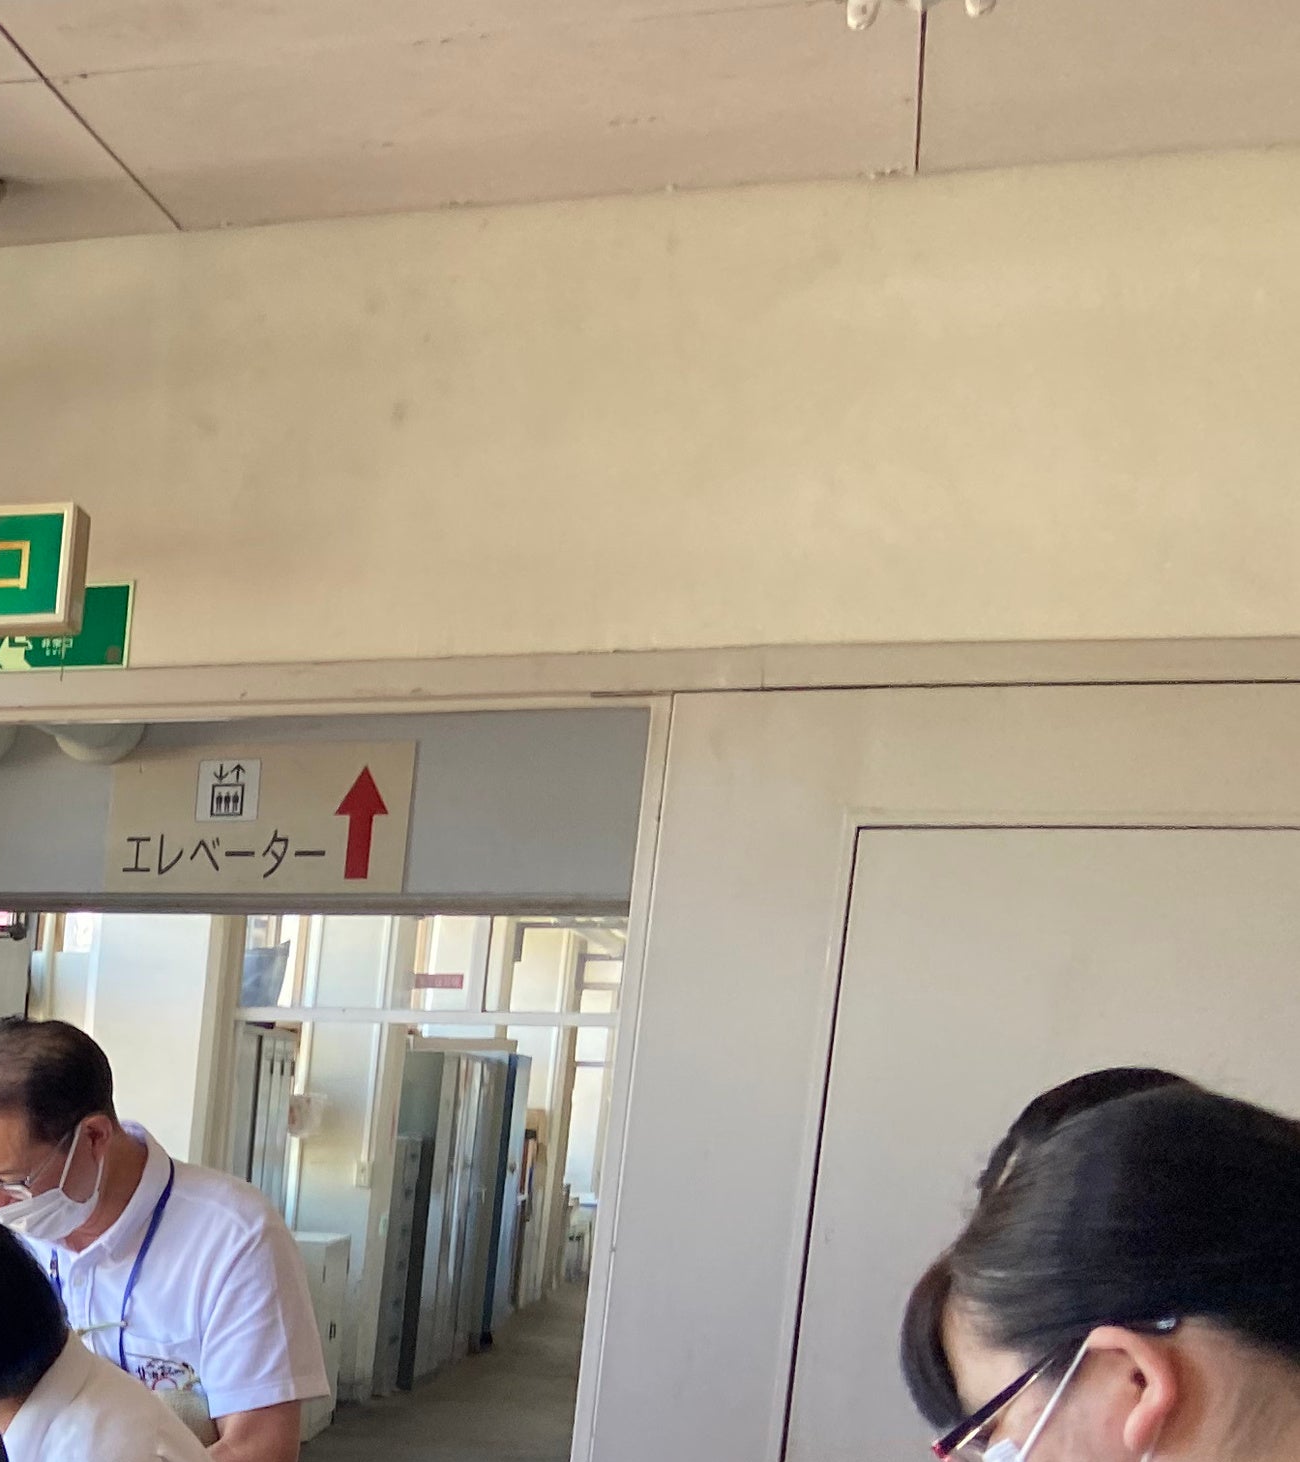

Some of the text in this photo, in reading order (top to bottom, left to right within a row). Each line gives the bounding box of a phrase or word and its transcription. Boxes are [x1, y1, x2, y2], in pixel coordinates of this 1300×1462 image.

[122, 829, 326, 879] エレベーター
